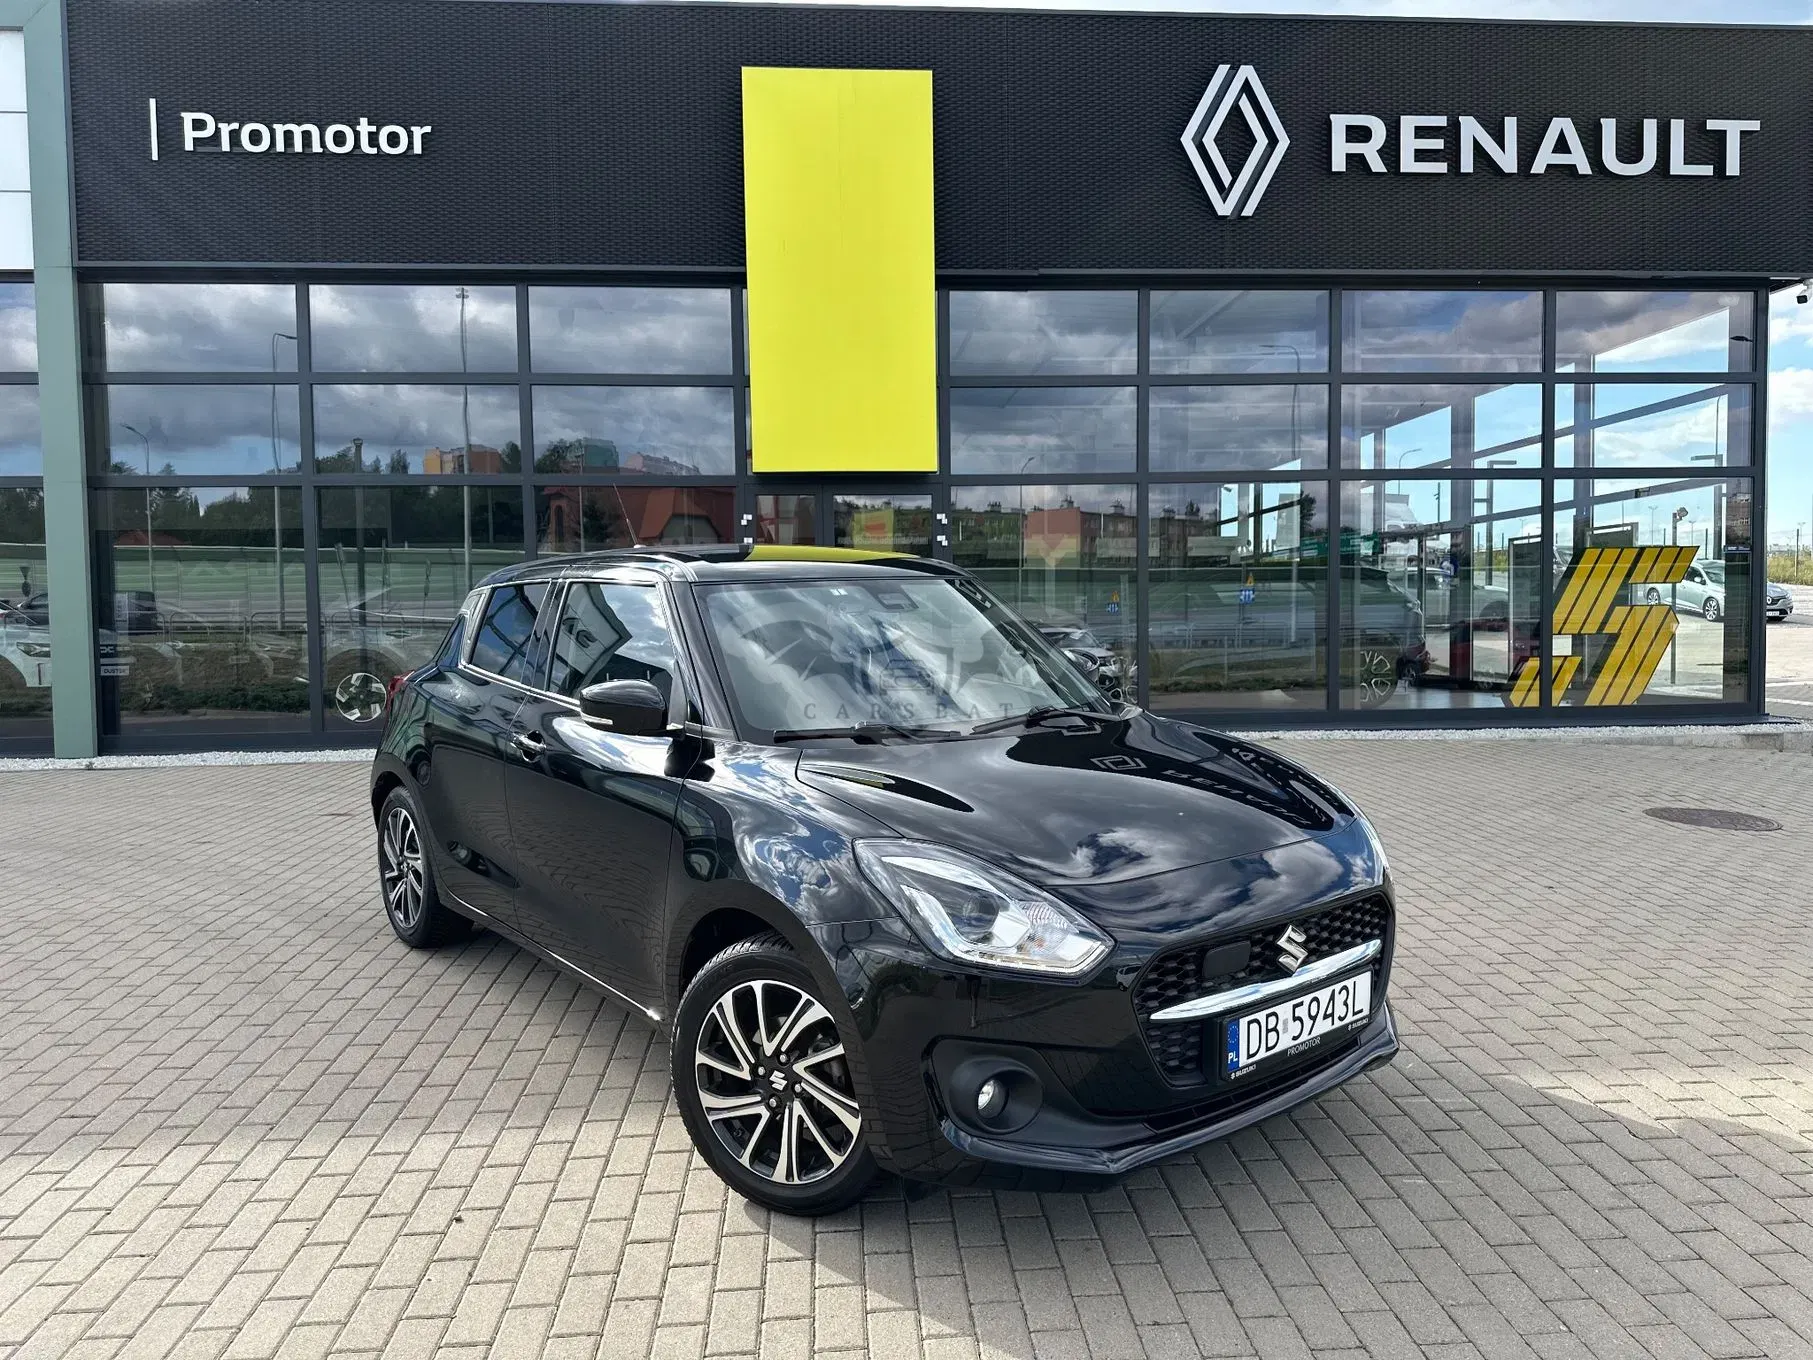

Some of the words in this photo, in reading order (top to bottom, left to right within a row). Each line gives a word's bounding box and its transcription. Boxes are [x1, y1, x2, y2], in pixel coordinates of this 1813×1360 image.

[181, 111, 431, 155] Promotor
[1329, 113, 1761, 177] RENAULT
[1247, 1011, 1279, 1059] DB
[1292, 981, 1363, 1040] 5943L
[1227, 1050, 1237, 1063] PL
[1287, 1037, 1320, 1056] PROMOTOR
